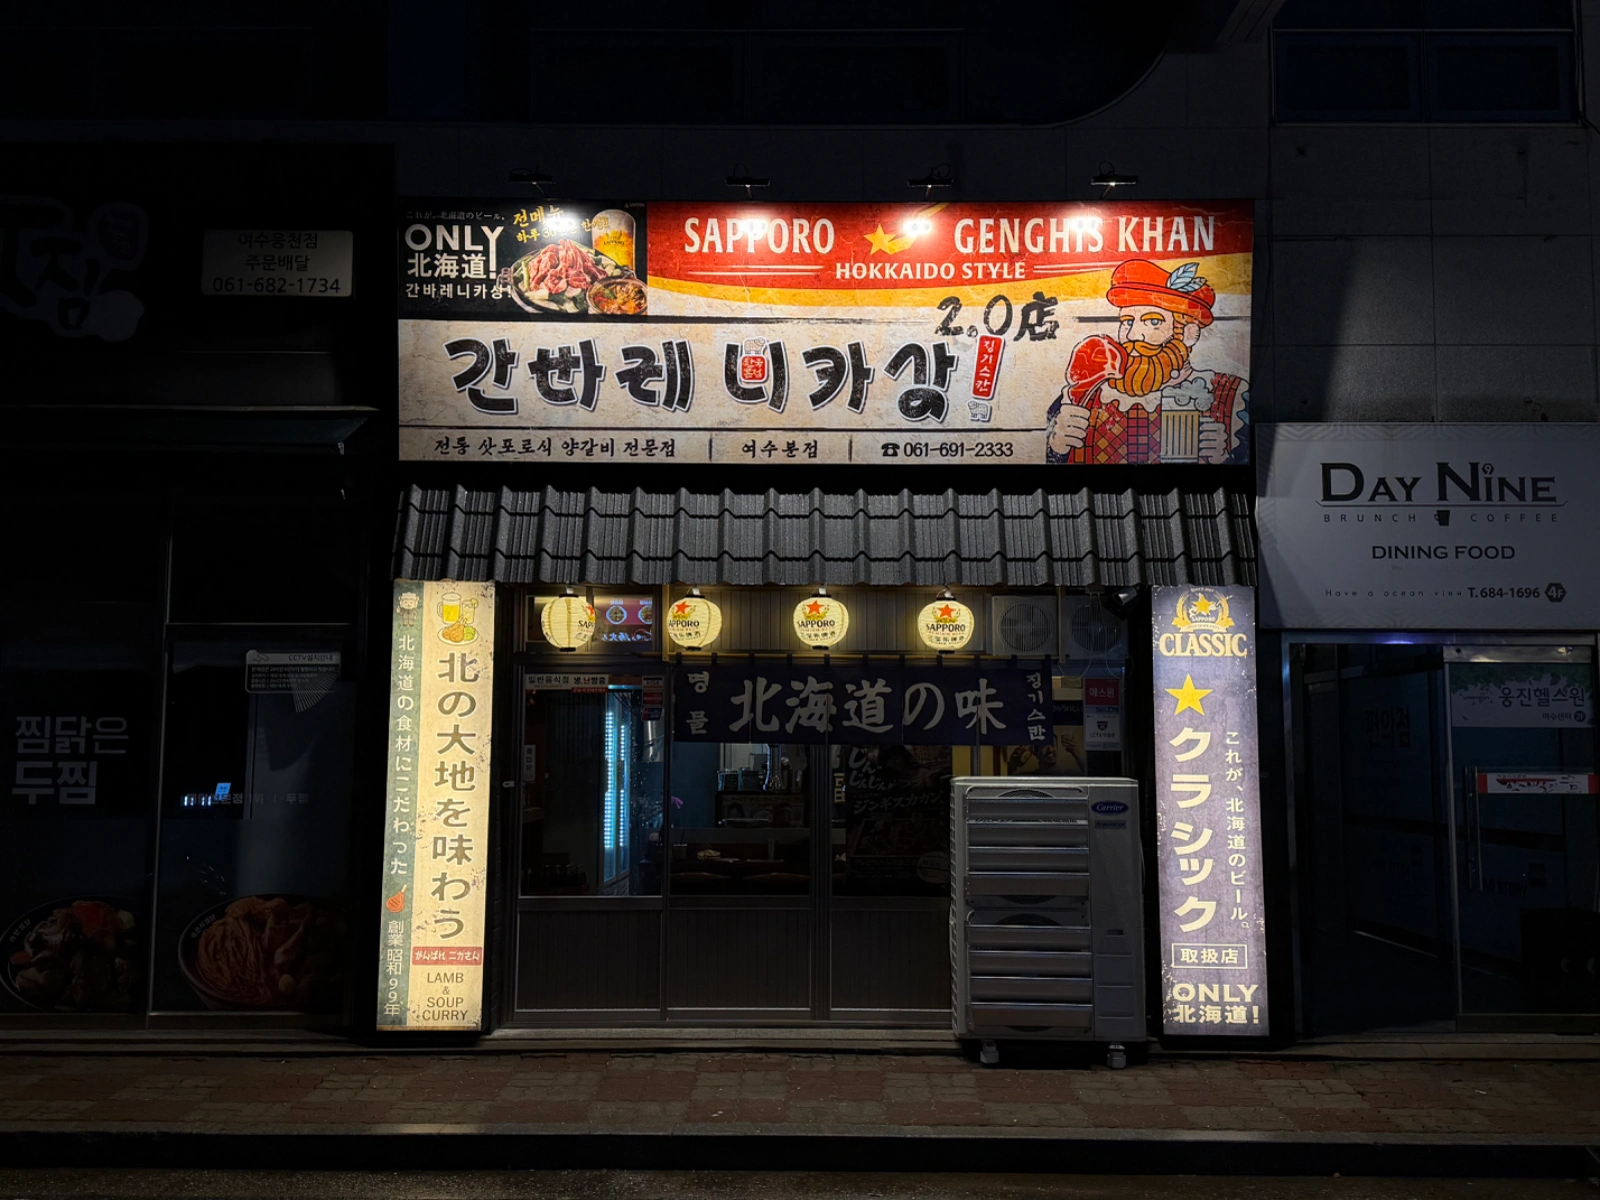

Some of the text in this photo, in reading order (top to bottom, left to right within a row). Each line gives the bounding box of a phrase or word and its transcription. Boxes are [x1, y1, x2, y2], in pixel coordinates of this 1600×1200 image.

[238, 232, 318, 249] 여수웅천점
[684, 215, 1215, 254] SAPPORO GENGHIS KHAN
[405, 223, 504, 269] ONLY
[245, 254, 310, 271] 주문배달
[835, 261, 1026, 281] HOKKAIDO STYLE
[212, 277, 341, 293] 061-682-1734
[434, 436, 676, 457] 전통 삿포로식 양갈비 전문점
[903, 441, 1014, 458] 061-691-2333
[1319, 462, 1422, 502] DAY
[1323, 513, 1559, 523] BRUNCH COFFEE
[1371, 545, 1516, 560] DINING FOOD
[1468, 586, 1540, 599] T.684-1696
[1159, 633, 1248, 657] CLASSIC
[729, 675, 1007, 736] 北海道の味
[1498, 686, 1586, 708] 웅진헬스원
[15, 715, 129, 754] 찜닭은
[390, 634, 416, 875] 北海道の食材にこだわった
[11, 760, 98, 805] 두찜
[430, 652, 480, 939] 北の大地を味わう
[1168, 726, 1217, 933] クラシック
[1224, 731, 1250, 930] これが、北海道のビール。
[1180, 948, 1239, 964] 取扱店
[426, 972, 464, 984] LAMB
[442, 986, 450, 995] &
[1172, 983, 1259, 1003] ONLY
[426, 997, 464, 1008] SOUP
[421, 1009, 468, 1021] CURRY
[1172, 1004, 1260, 1025] 北海道!
